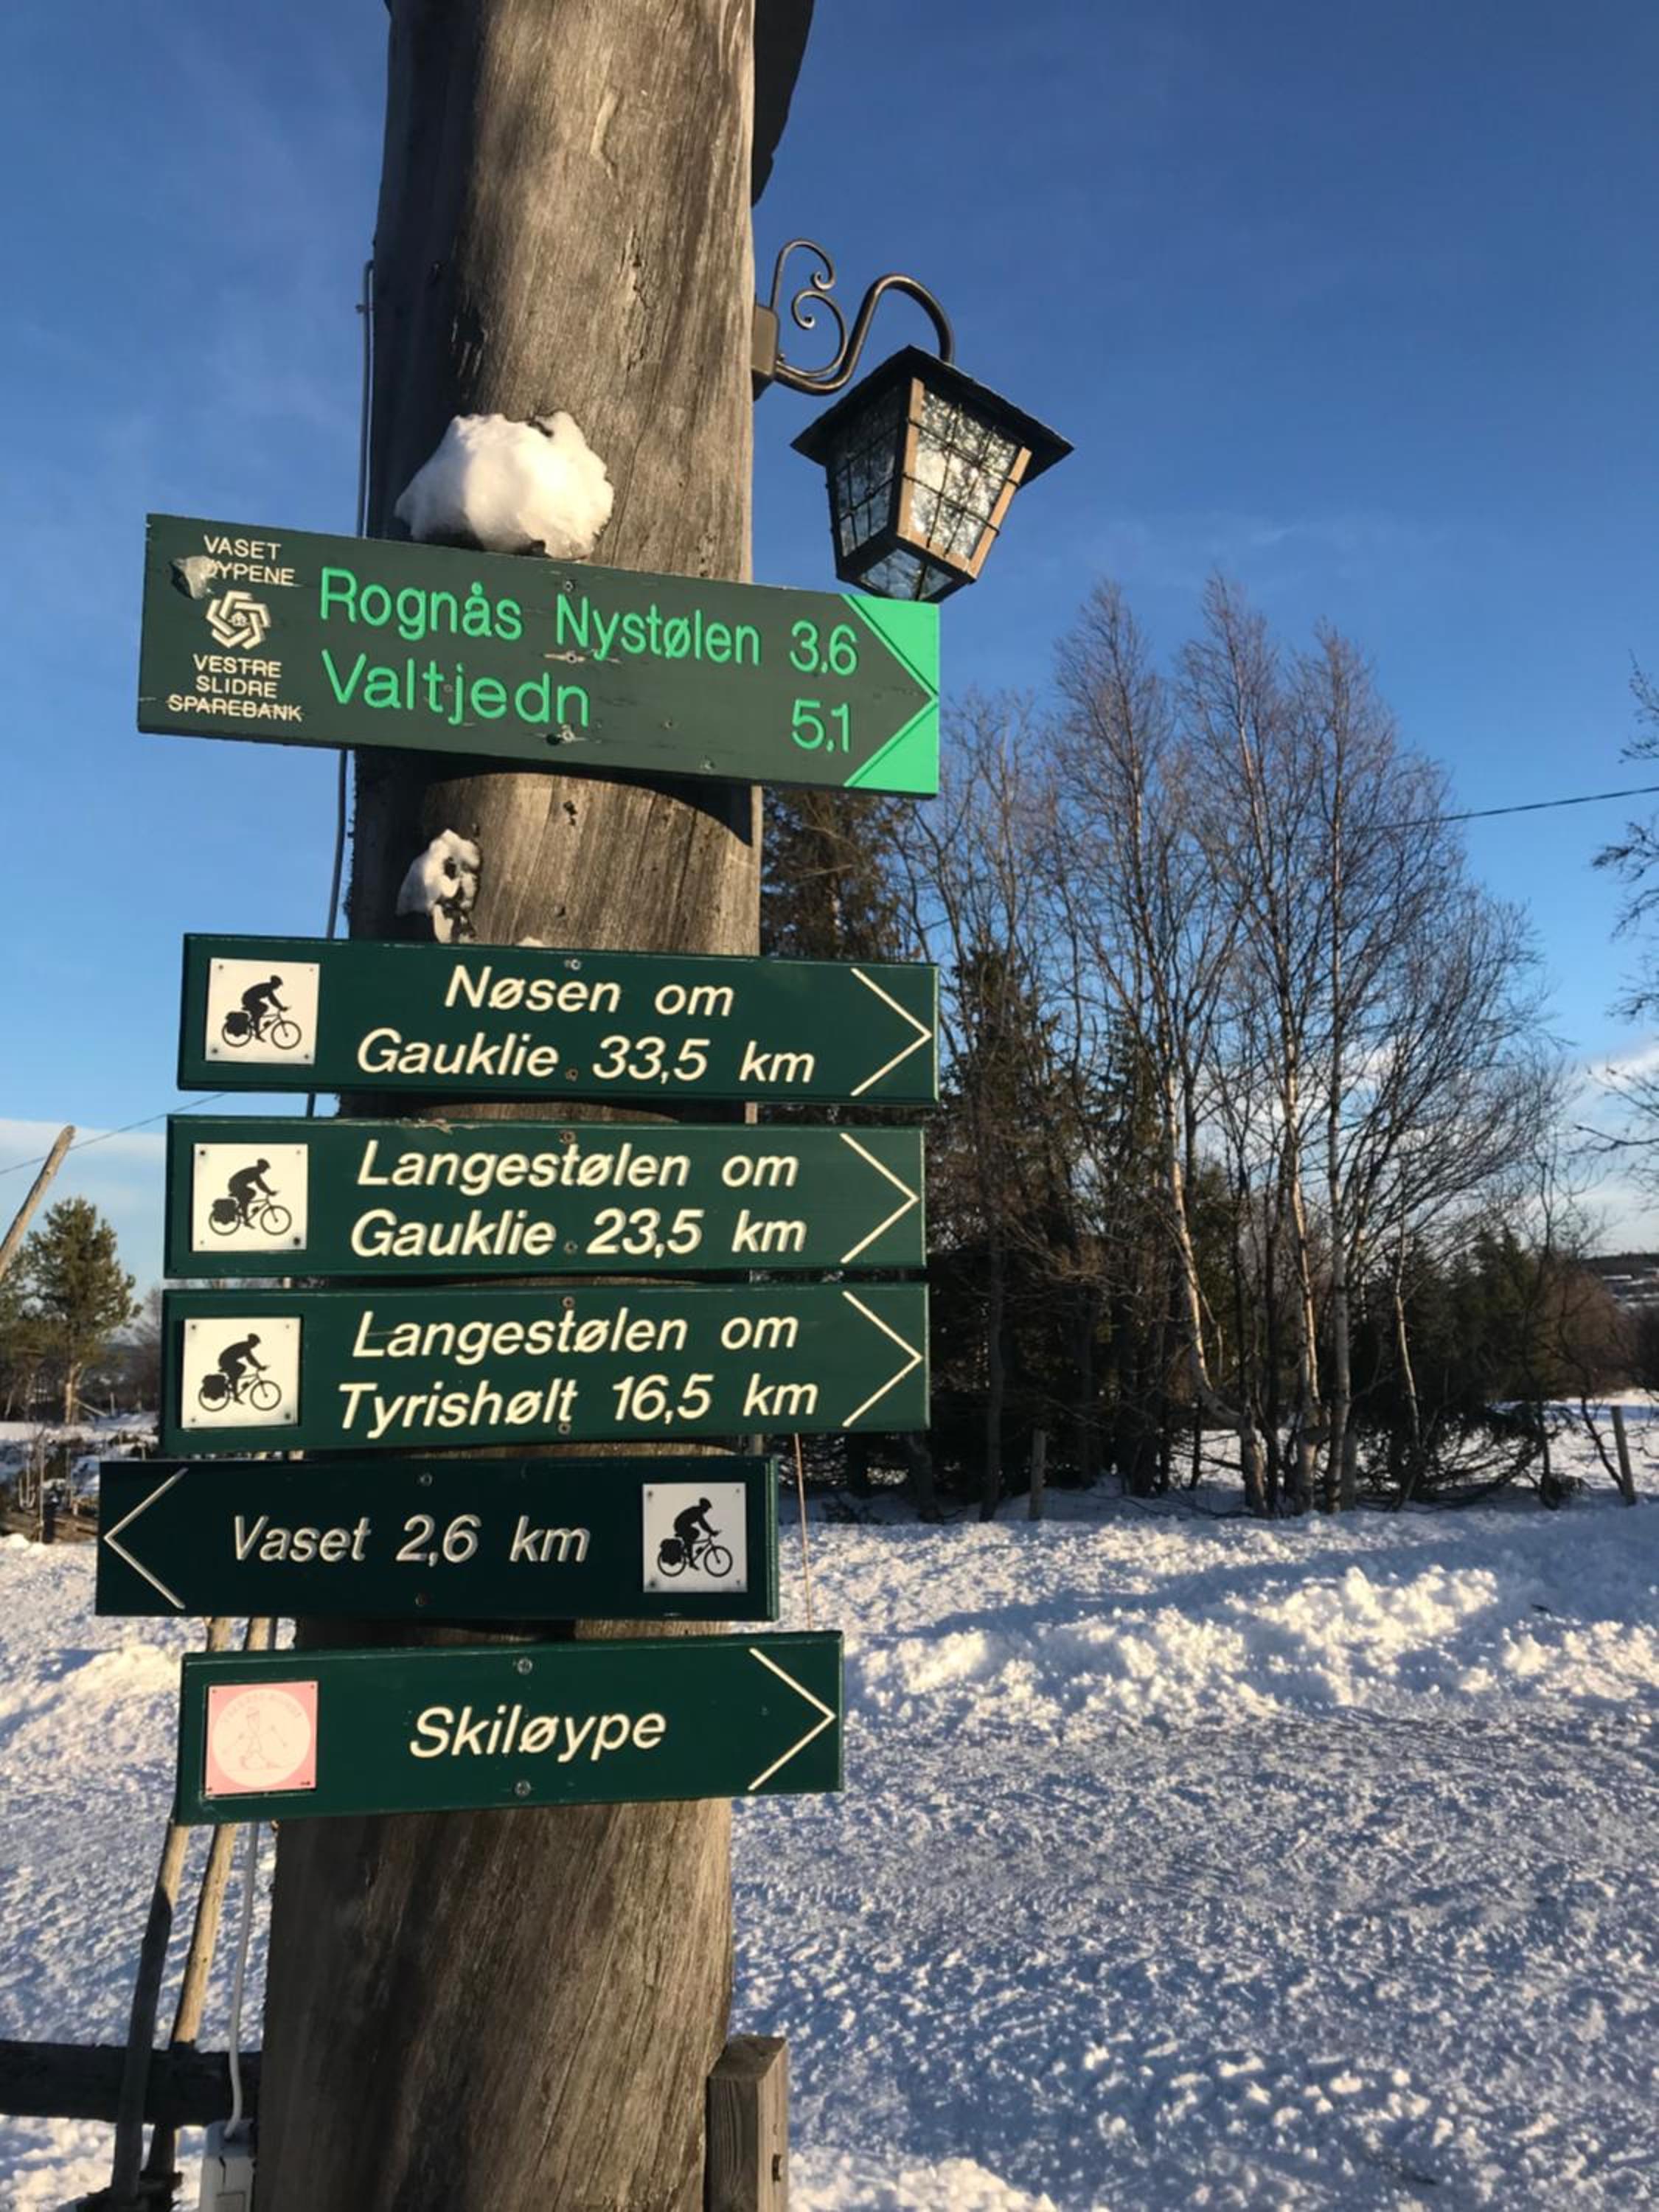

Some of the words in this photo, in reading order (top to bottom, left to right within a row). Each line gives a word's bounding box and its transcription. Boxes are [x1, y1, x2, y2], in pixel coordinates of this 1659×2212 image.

[203, 534, 282, 560] VASET
[207, 558, 296, 587] YPENE
[320, 567, 523, 641] Rognås
[556, 594, 760, 665] Nystølen
[790, 620, 858, 676] 3,6
[193, 653, 282, 686] VESTRE
[195, 675, 278, 699] SLIDRE
[167, 694, 304, 723] SPAREBANK
[321, 649, 590, 726] Valtjedn
[791, 698, 851, 753] 5,1
[445, 964, 621, 1013] Nøsen
[654, 984, 734, 1017] om
[357, 1027, 559, 1078] Gauklie
[592, 1034, 711, 1085] 33,5
[739, 1040, 815, 1083] km
[357, 1139, 691, 1197] Langestølen
[721, 1155, 799, 1188] om
[350, 1208, 557, 1258] Gauklie
[586, 1208, 704, 1259] 23,5
[731, 1208, 807, 1253] km
[352, 1307, 689, 1366] Langestølen
[720, 1315, 799, 1350] om
[338, 1377, 578, 1439] Tyrishølt
[612, 1373, 715, 1425] 16,5
[742, 1372, 818, 1417] km
[234, 1514, 372, 1563] Vaset
[395, 1514, 480, 1568] 2,6
[509, 1514, 591, 1562] km
[409, 1704, 667, 1763] Skiløype
